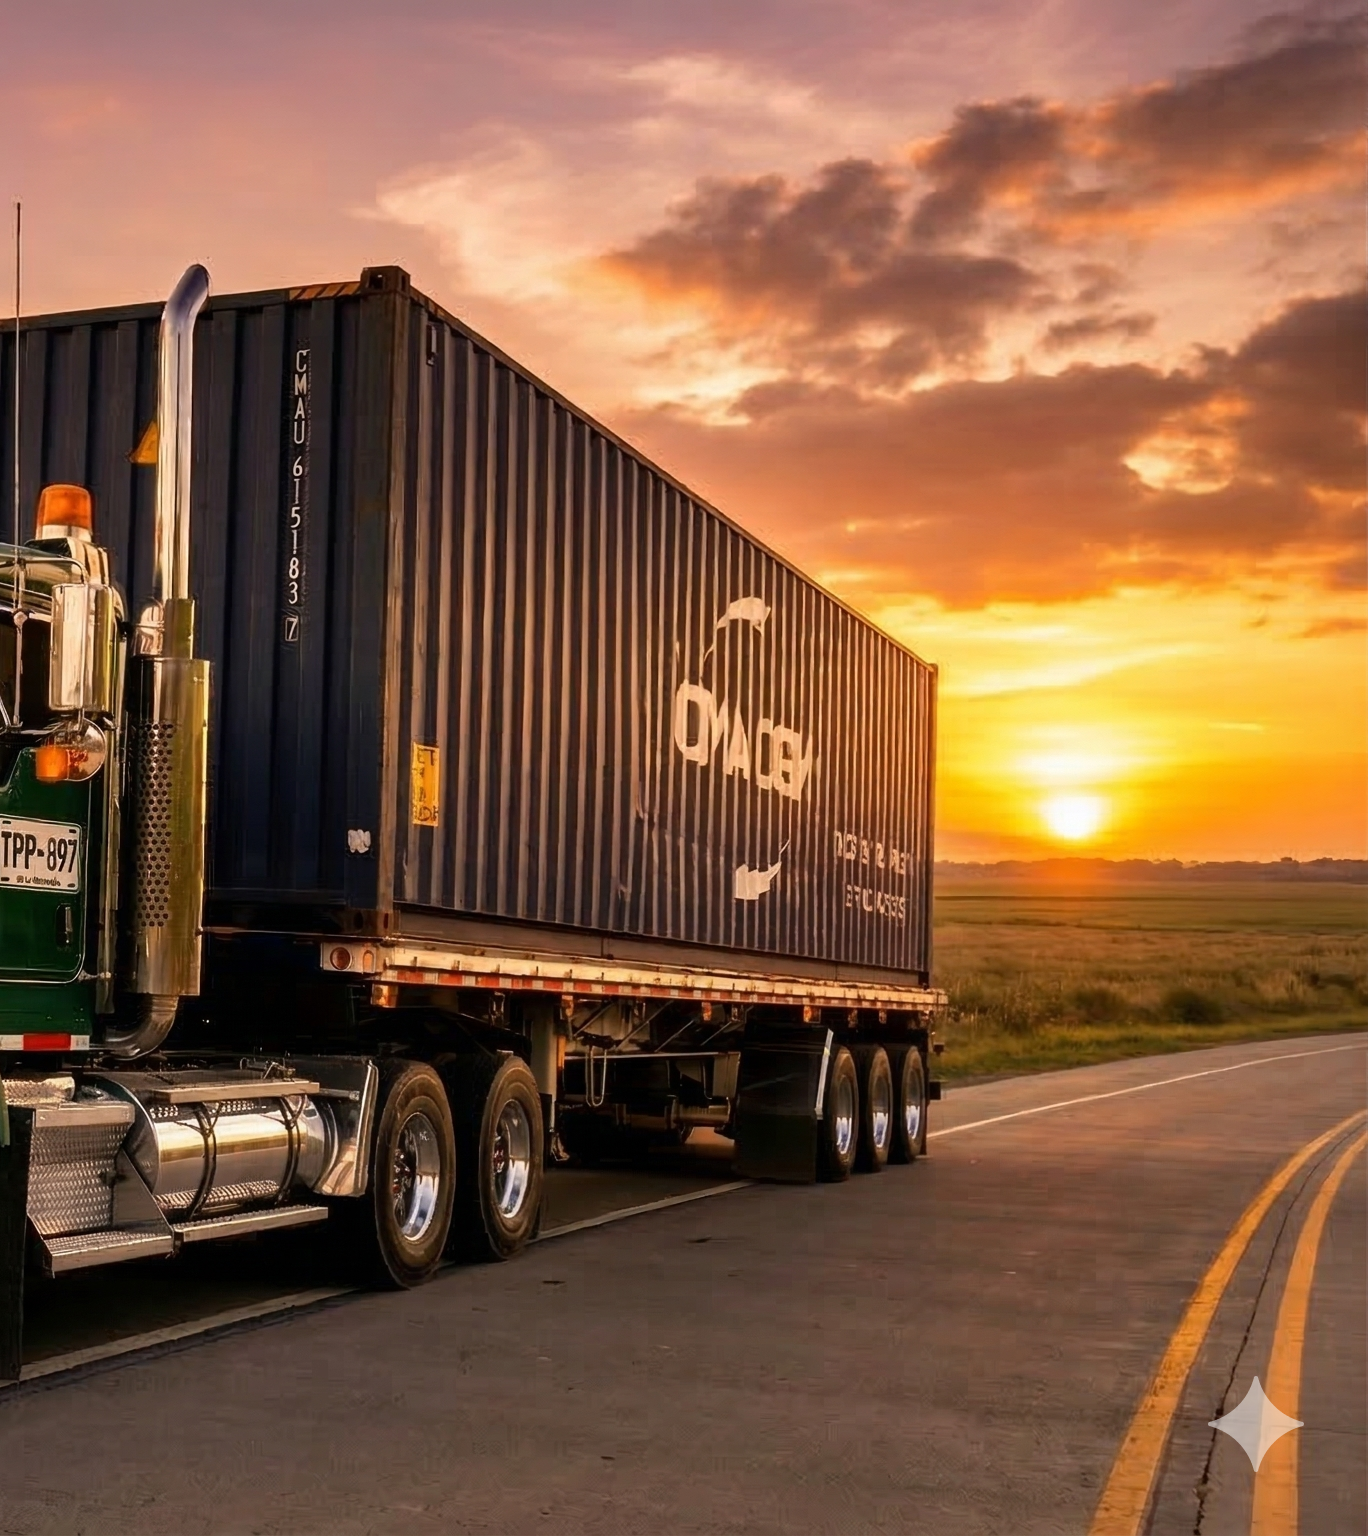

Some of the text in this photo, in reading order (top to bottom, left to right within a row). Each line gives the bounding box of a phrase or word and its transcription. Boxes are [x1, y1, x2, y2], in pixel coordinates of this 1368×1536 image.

[287, 349, 308, 640] CMAU 615183 7
[1, 831, 78, 873] TPP-897
